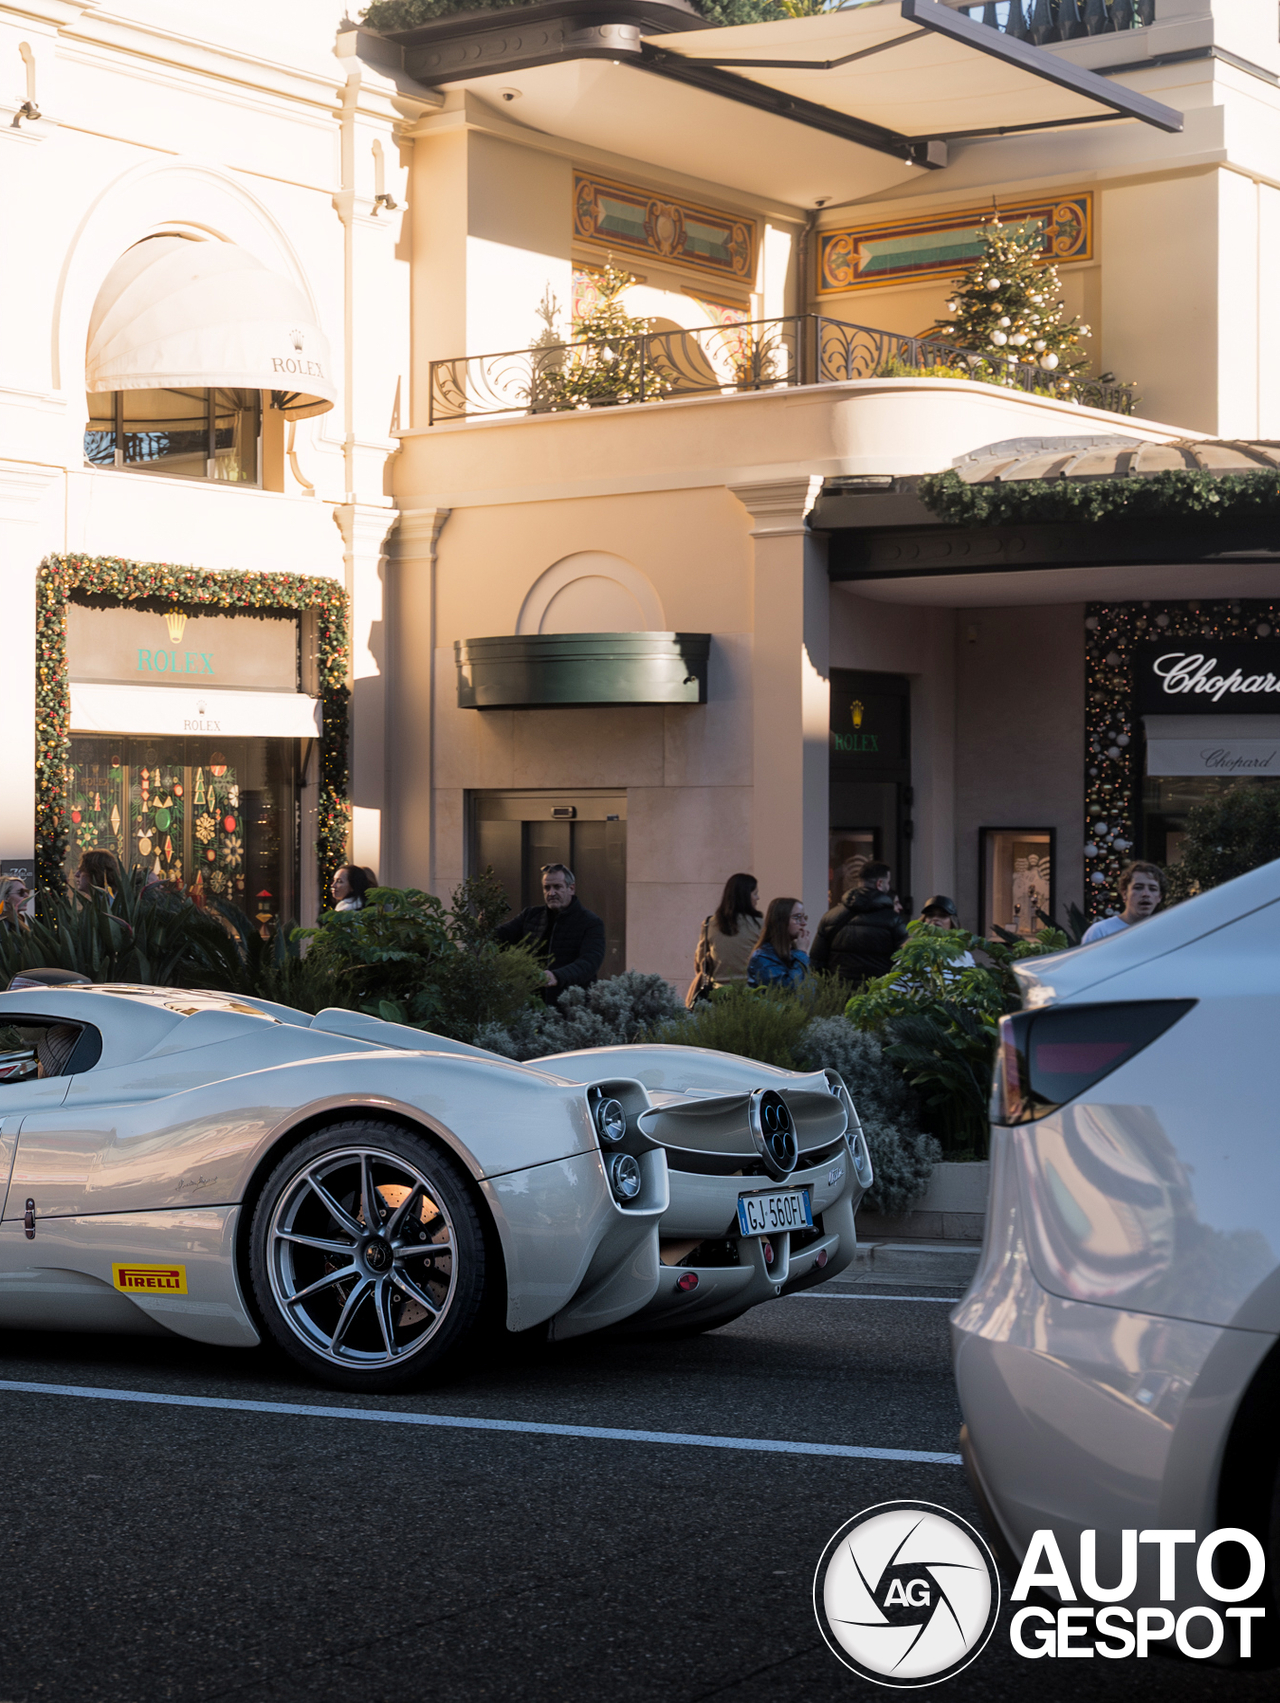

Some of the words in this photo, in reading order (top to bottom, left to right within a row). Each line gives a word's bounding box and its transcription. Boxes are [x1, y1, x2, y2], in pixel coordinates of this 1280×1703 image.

[271, 358, 325, 379] ROLEX
[136, 649, 216, 675] ROLEX
[1153, 652, 1280, 702] Chopar
[183, 719, 222, 732] ROLEX
[834, 733, 879, 752] ROLEX
[1200, 747, 1277, 772] Chopard
[80, 777, 110, 787] ROLEX
[118, 1268, 180, 1289] PIRELLI
